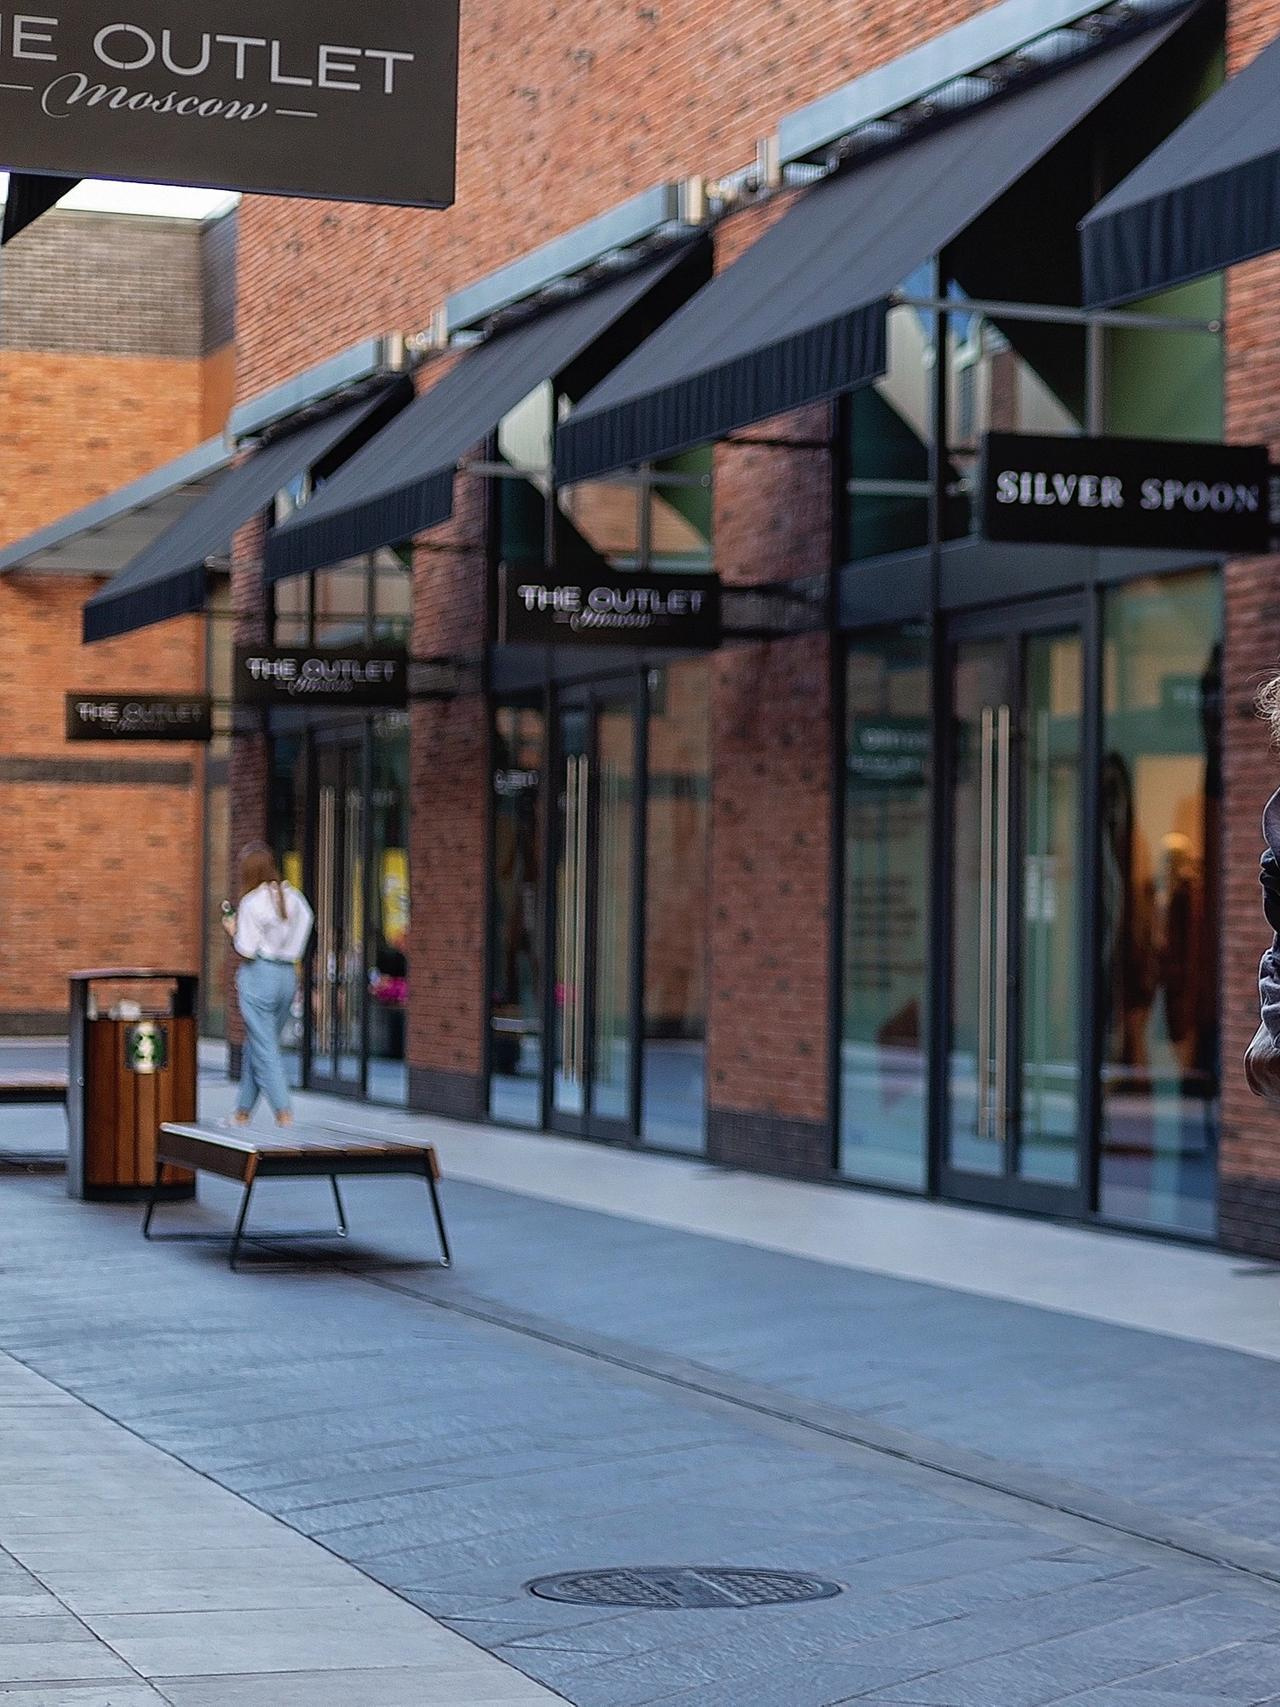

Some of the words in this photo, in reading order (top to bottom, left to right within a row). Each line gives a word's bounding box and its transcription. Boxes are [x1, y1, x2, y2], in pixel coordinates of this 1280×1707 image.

[93, 23, 415, 94] OUTLET
[41, 72, 268, 120] Moscow
[996, 470, 1124, 508] SILVER
[1140, 477, 1259, 513] SPOON
[517, 584, 582, 612] THE
[588, 586, 706, 615] OUTLET
[246, 657, 298, 681] THE
[302, 658, 398, 683] OUTLET
